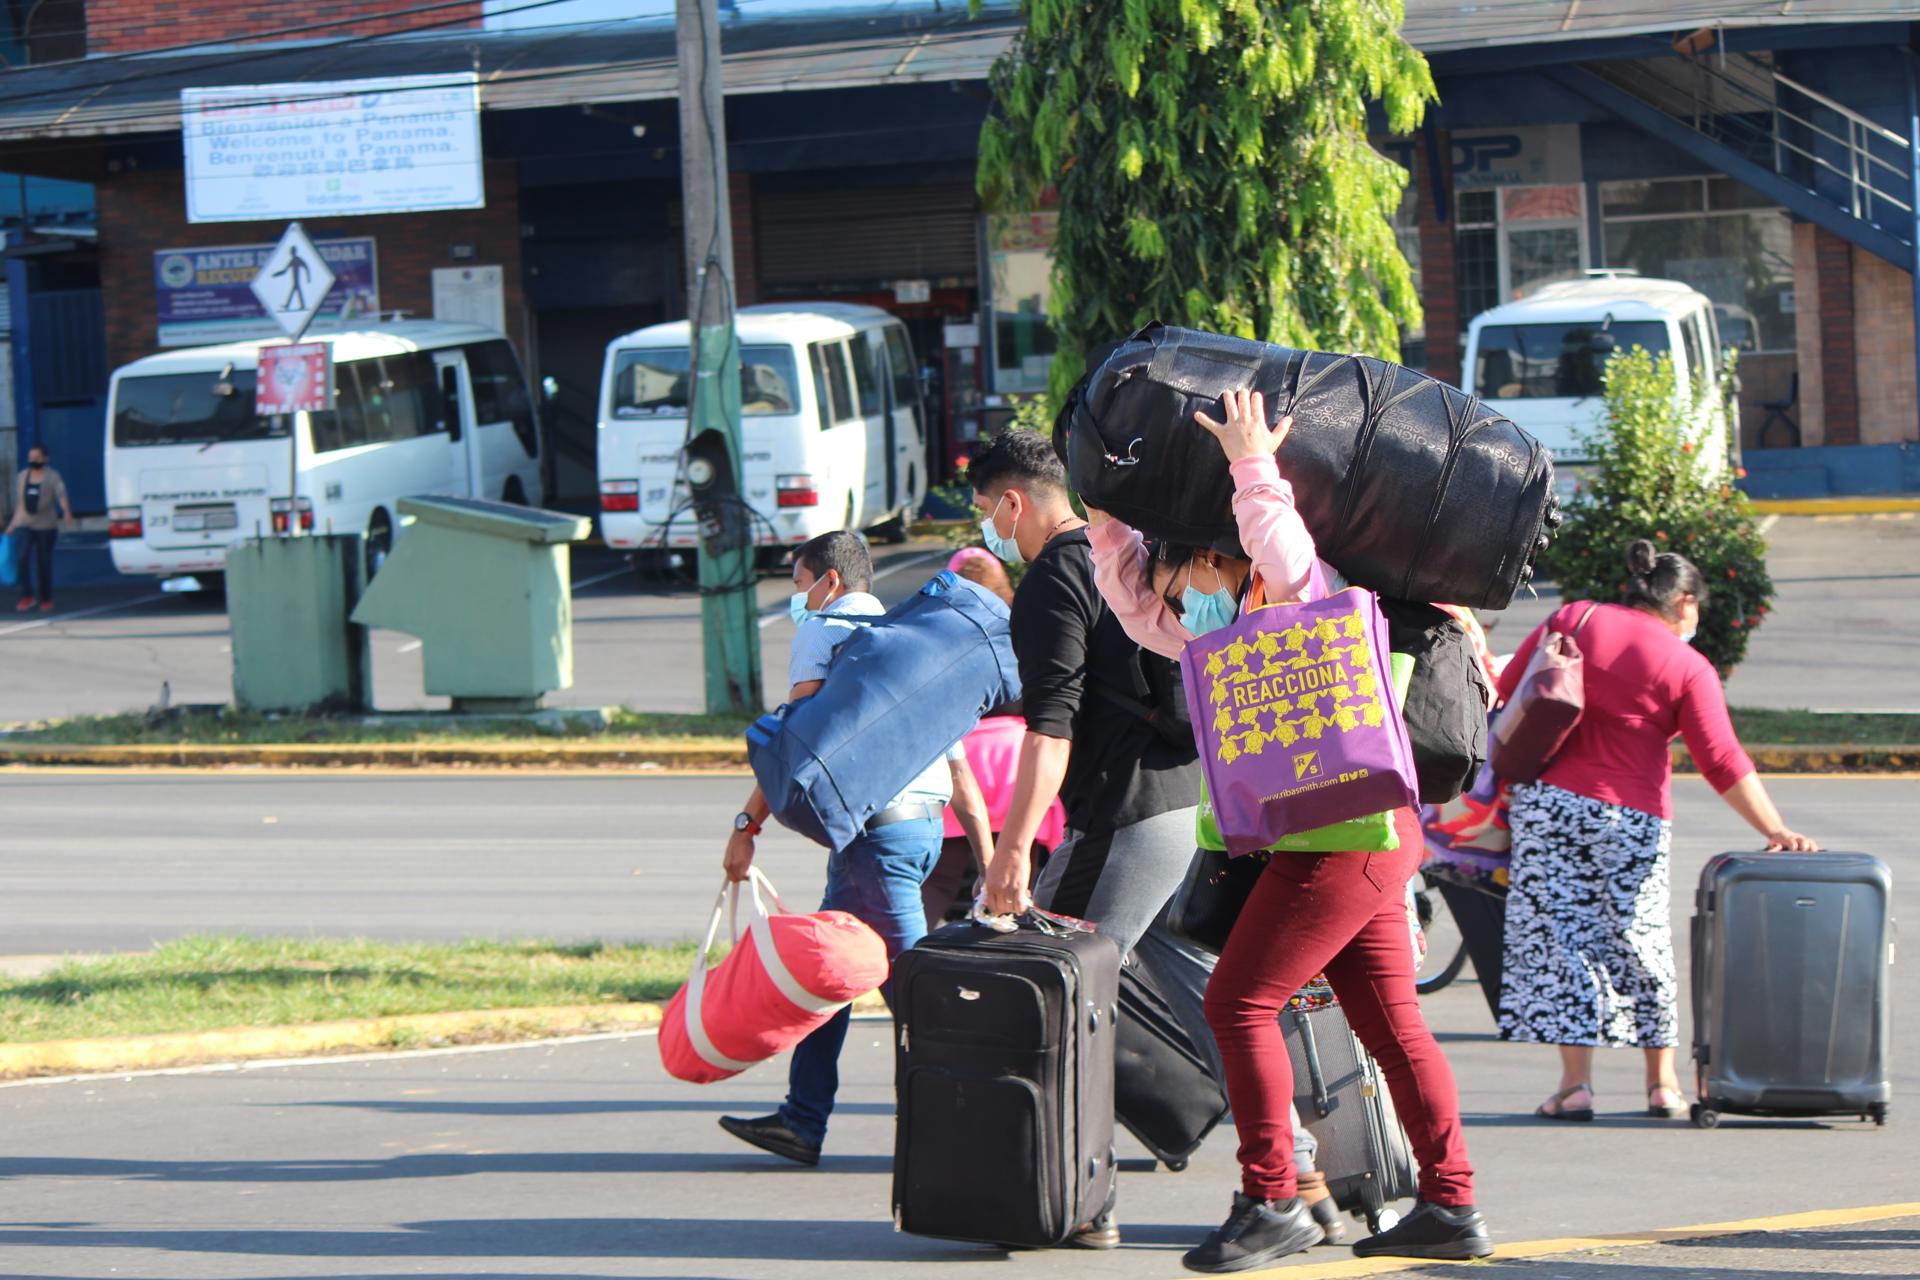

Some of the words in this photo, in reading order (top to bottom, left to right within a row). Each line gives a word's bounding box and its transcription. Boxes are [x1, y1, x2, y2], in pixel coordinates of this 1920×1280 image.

[340, 116, 352, 128] a
[210, 131, 313, 150] Welcome
[323, 131, 345, 145] to
[209, 146, 325, 165] Benvenuti
[336, 148, 348, 159] a
[196, 252, 254, 269] ANTES
[1233, 662, 1348, 707] REACCIONA
[1258, 777, 1338, 804] www.ribasmith.com
